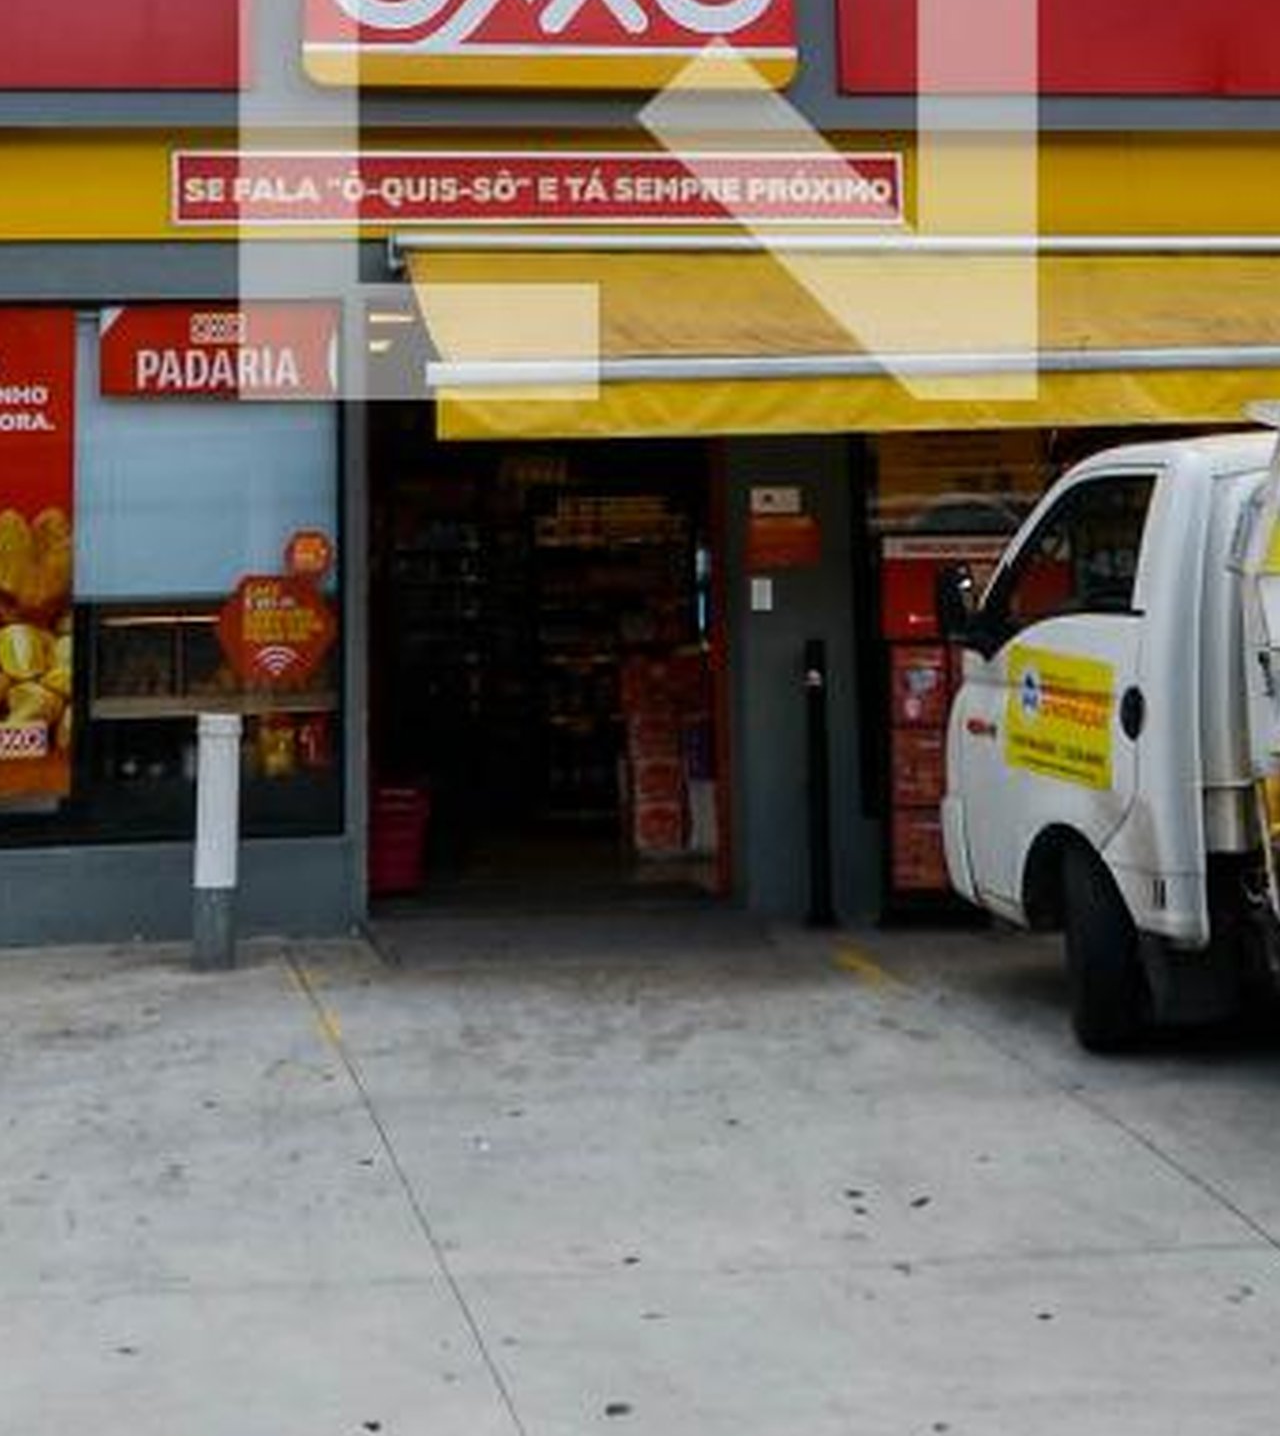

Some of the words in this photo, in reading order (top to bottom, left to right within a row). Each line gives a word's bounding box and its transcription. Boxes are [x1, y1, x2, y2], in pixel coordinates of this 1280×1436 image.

[184, 177, 225, 203] SE
[233, 177, 320, 203] FALA
[537, 176, 559, 202] E
[565, 168, 609, 202] TÁ
[613, 176, 741, 203] SEMPRE
[747, 168, 892, 204] PRÓXIMO
[136, 347, 299, 390] PADARIA
